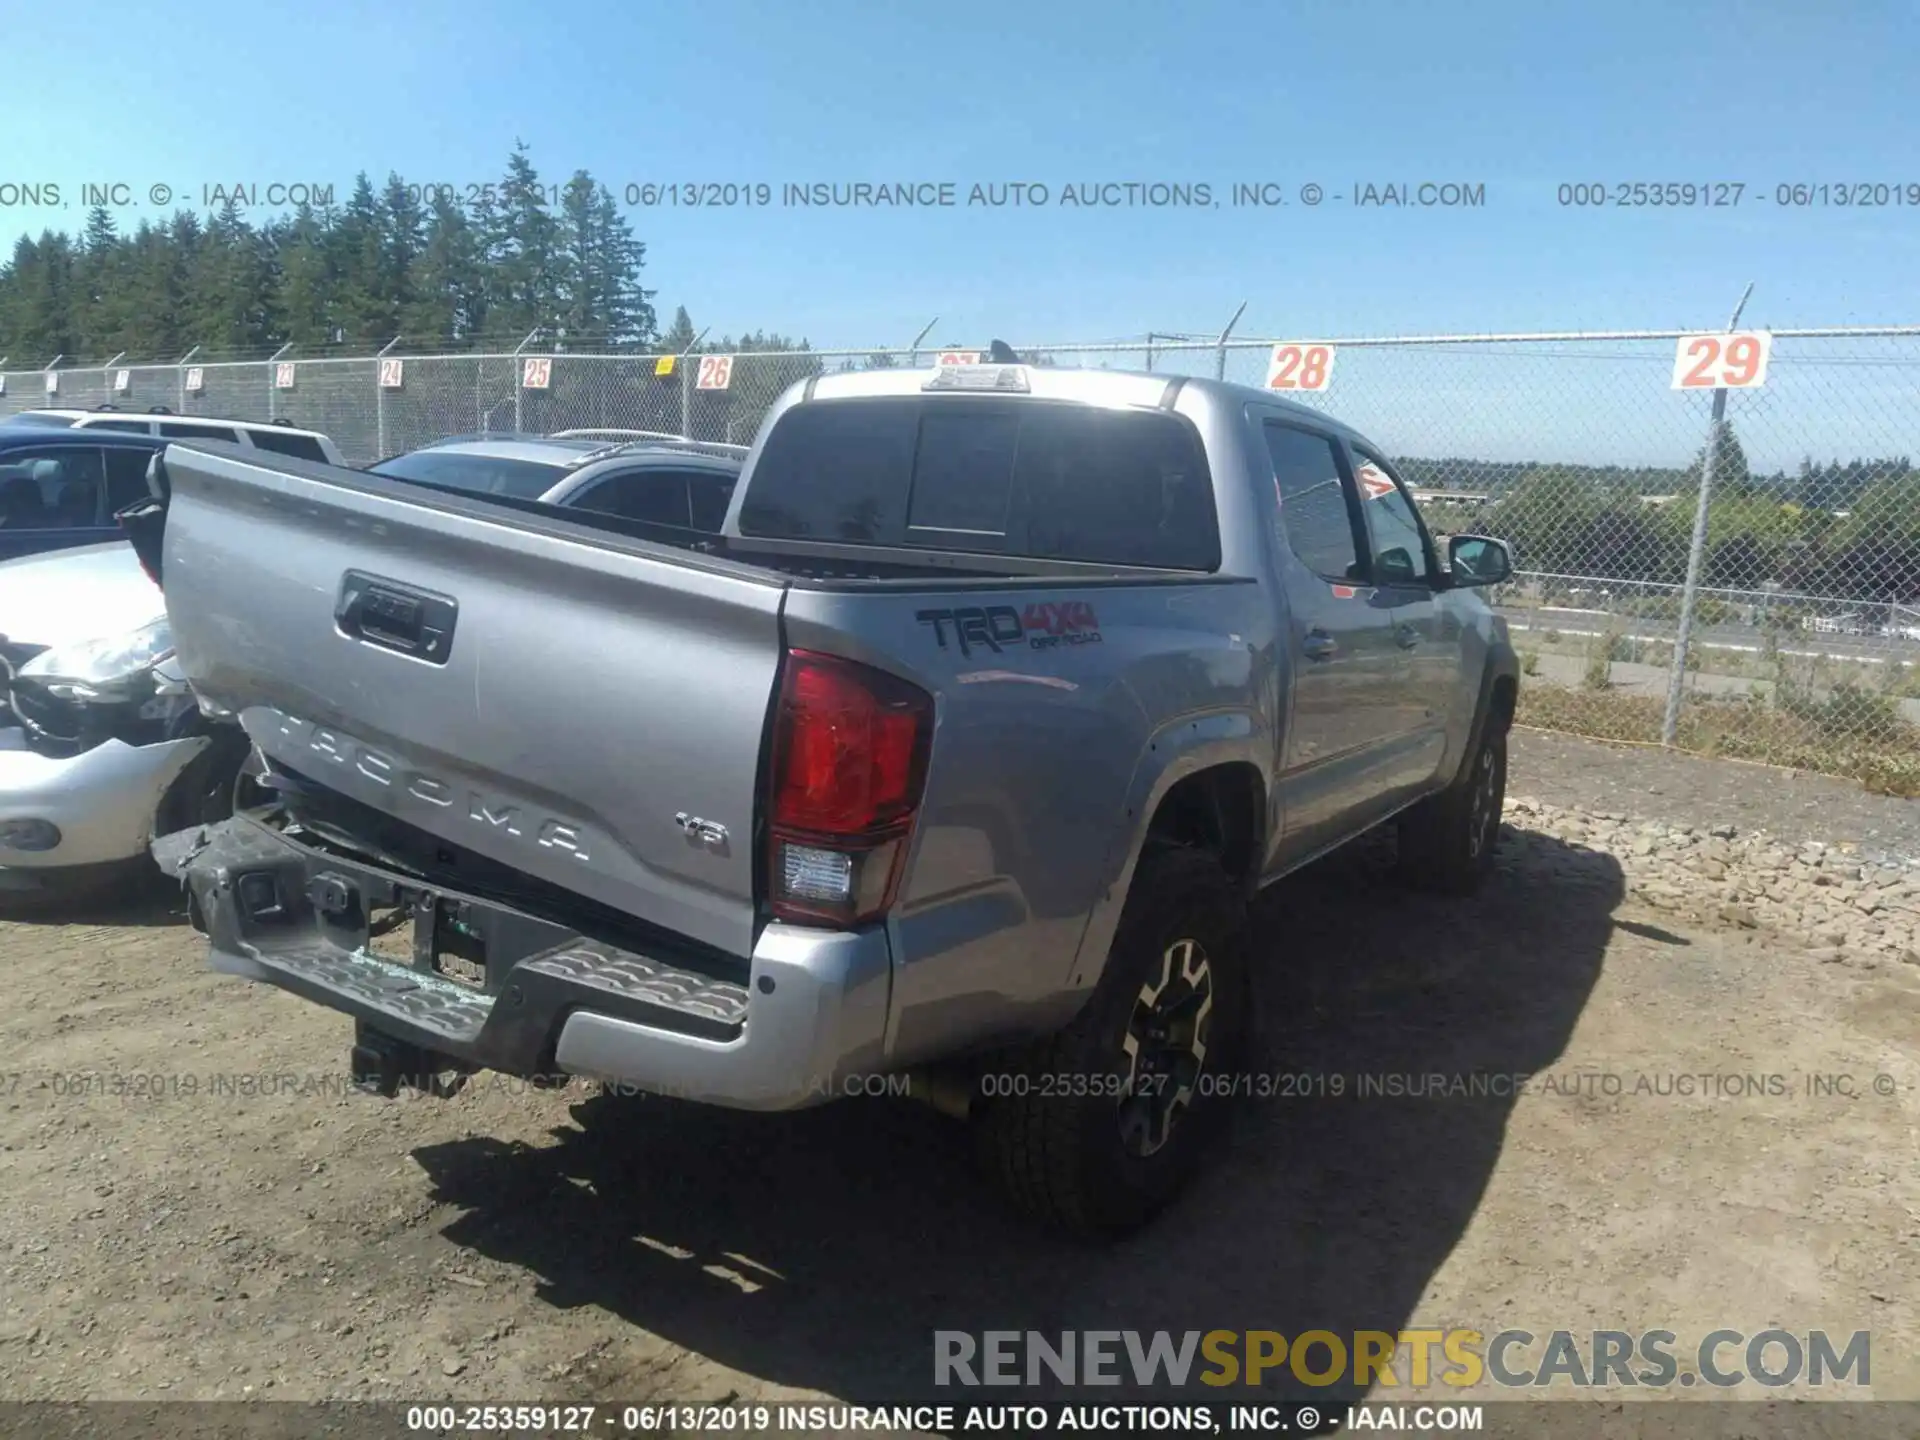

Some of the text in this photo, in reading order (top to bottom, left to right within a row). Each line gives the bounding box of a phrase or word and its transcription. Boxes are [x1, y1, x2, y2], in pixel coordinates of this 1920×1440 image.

[383, 361, 399, 385] 24
[525, 360, 548, 385] 25
[700, 358, 728, 387] 26
[1271, 346, 1329, 389] 28
[1681, 336, 1761, 386] 29
[915, 605, 1026, 660] TRD
